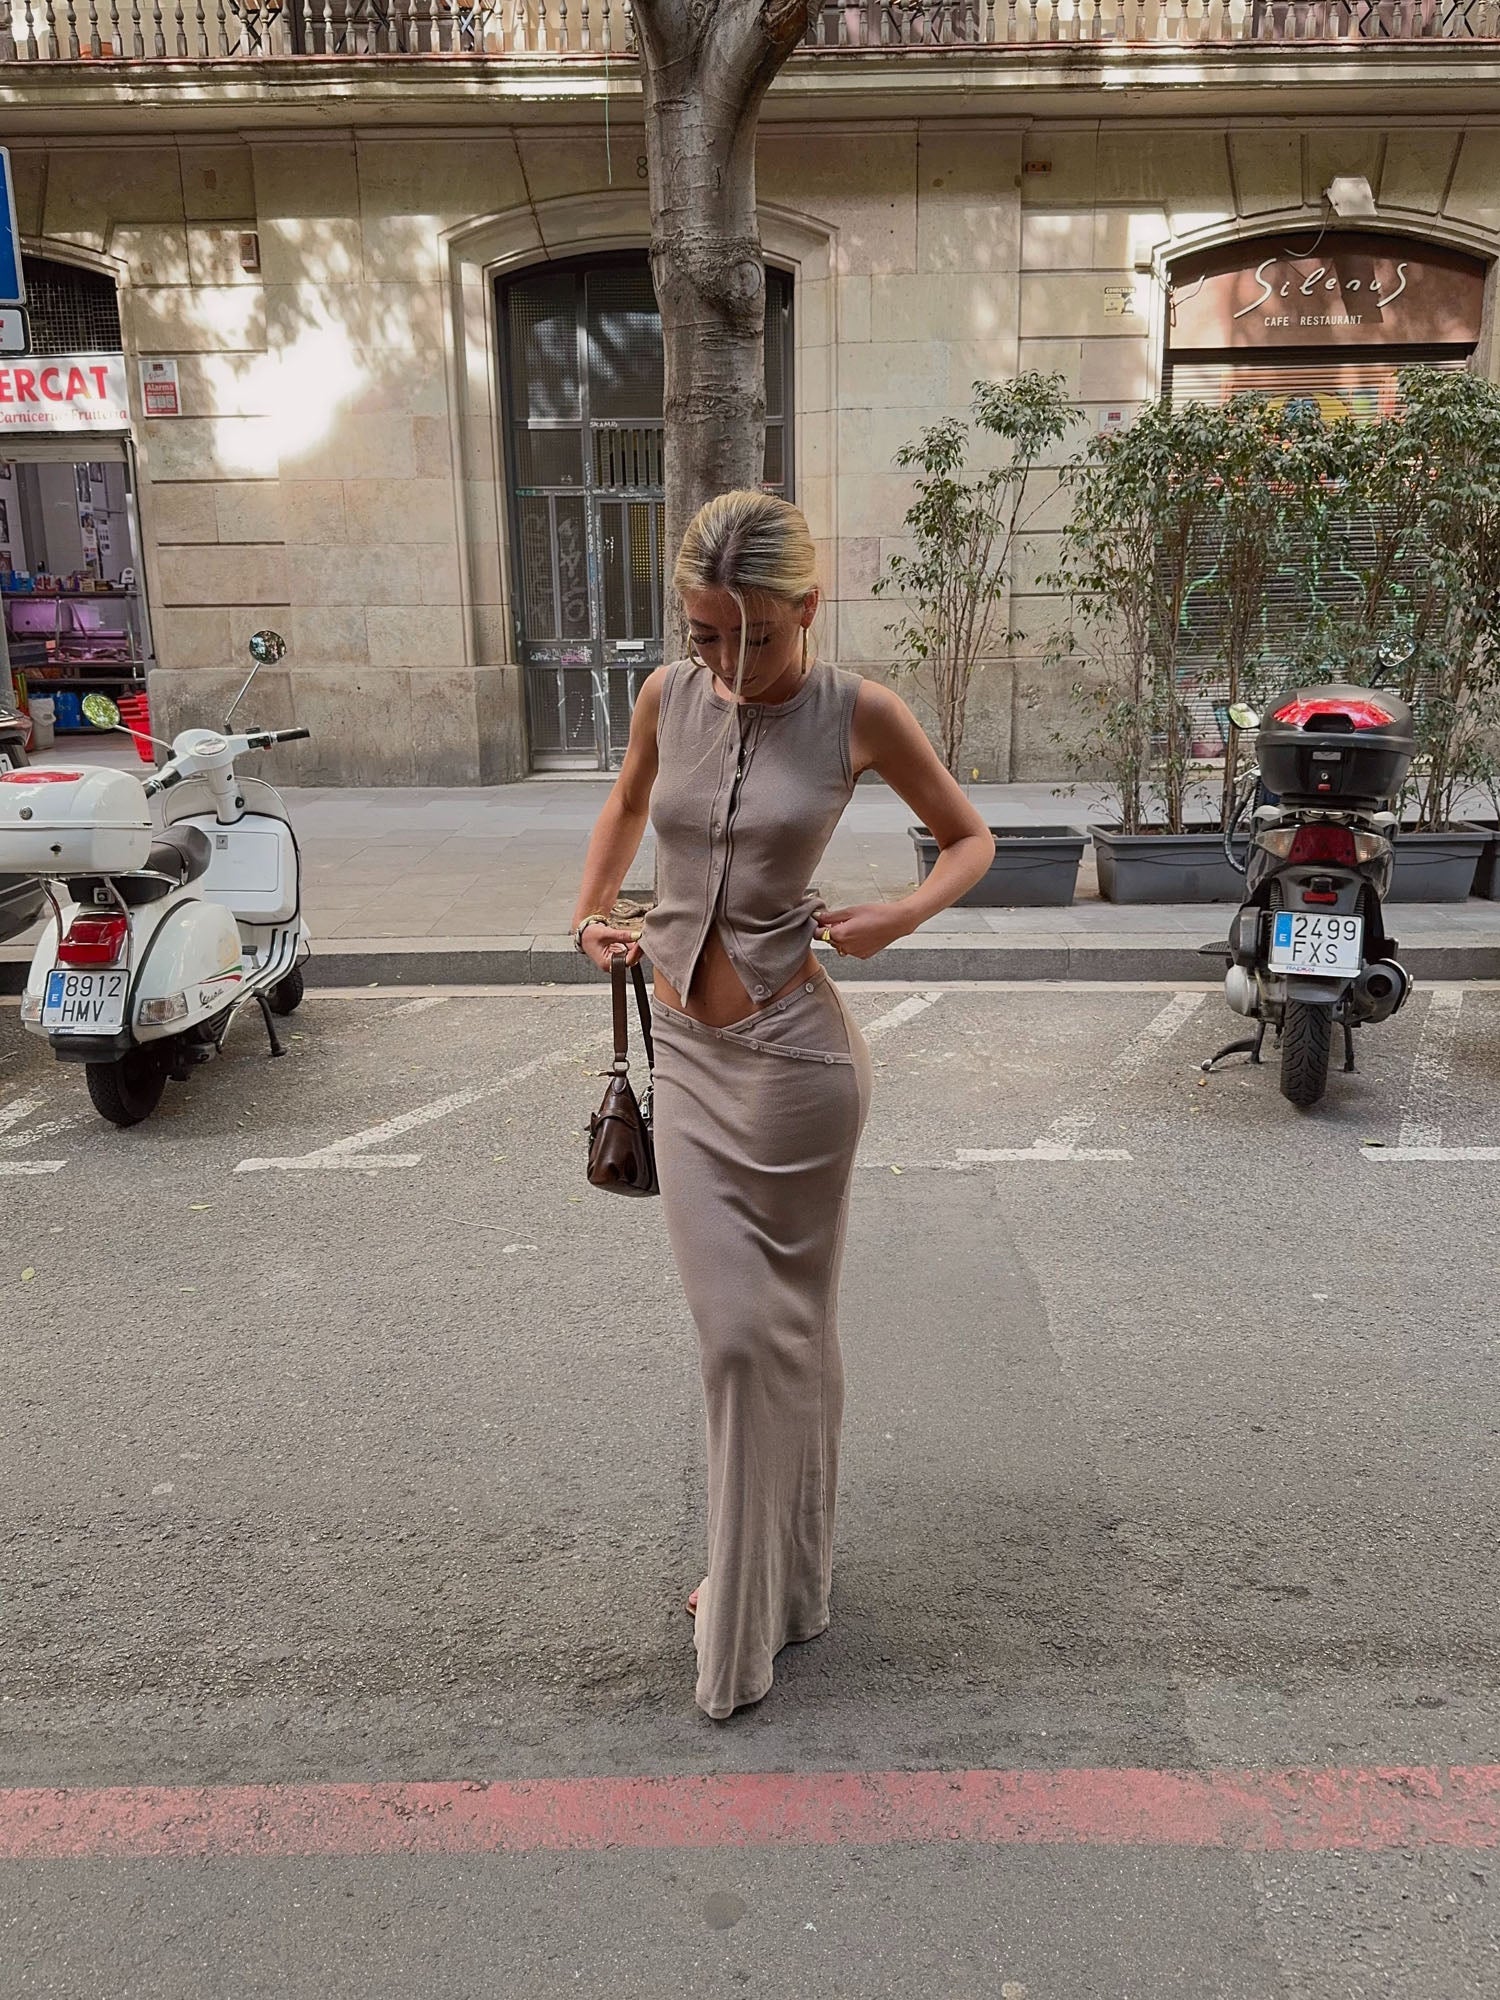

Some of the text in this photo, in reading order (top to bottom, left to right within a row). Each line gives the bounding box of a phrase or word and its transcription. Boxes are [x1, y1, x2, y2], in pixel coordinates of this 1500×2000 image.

[636, 155, 649, 179] 8
[1264, 315, 1363, 327] CAFE RESTAURANT
[1279, 933, 1288, 942] E
[1294, 917, 1356, 941] 2499
[1292, 941, 1338, 964] FXS
[65, 975, 122, 997] 8912
[51, 993, 60, 1002] E
[61, 1000, 105, 1022] HMV
